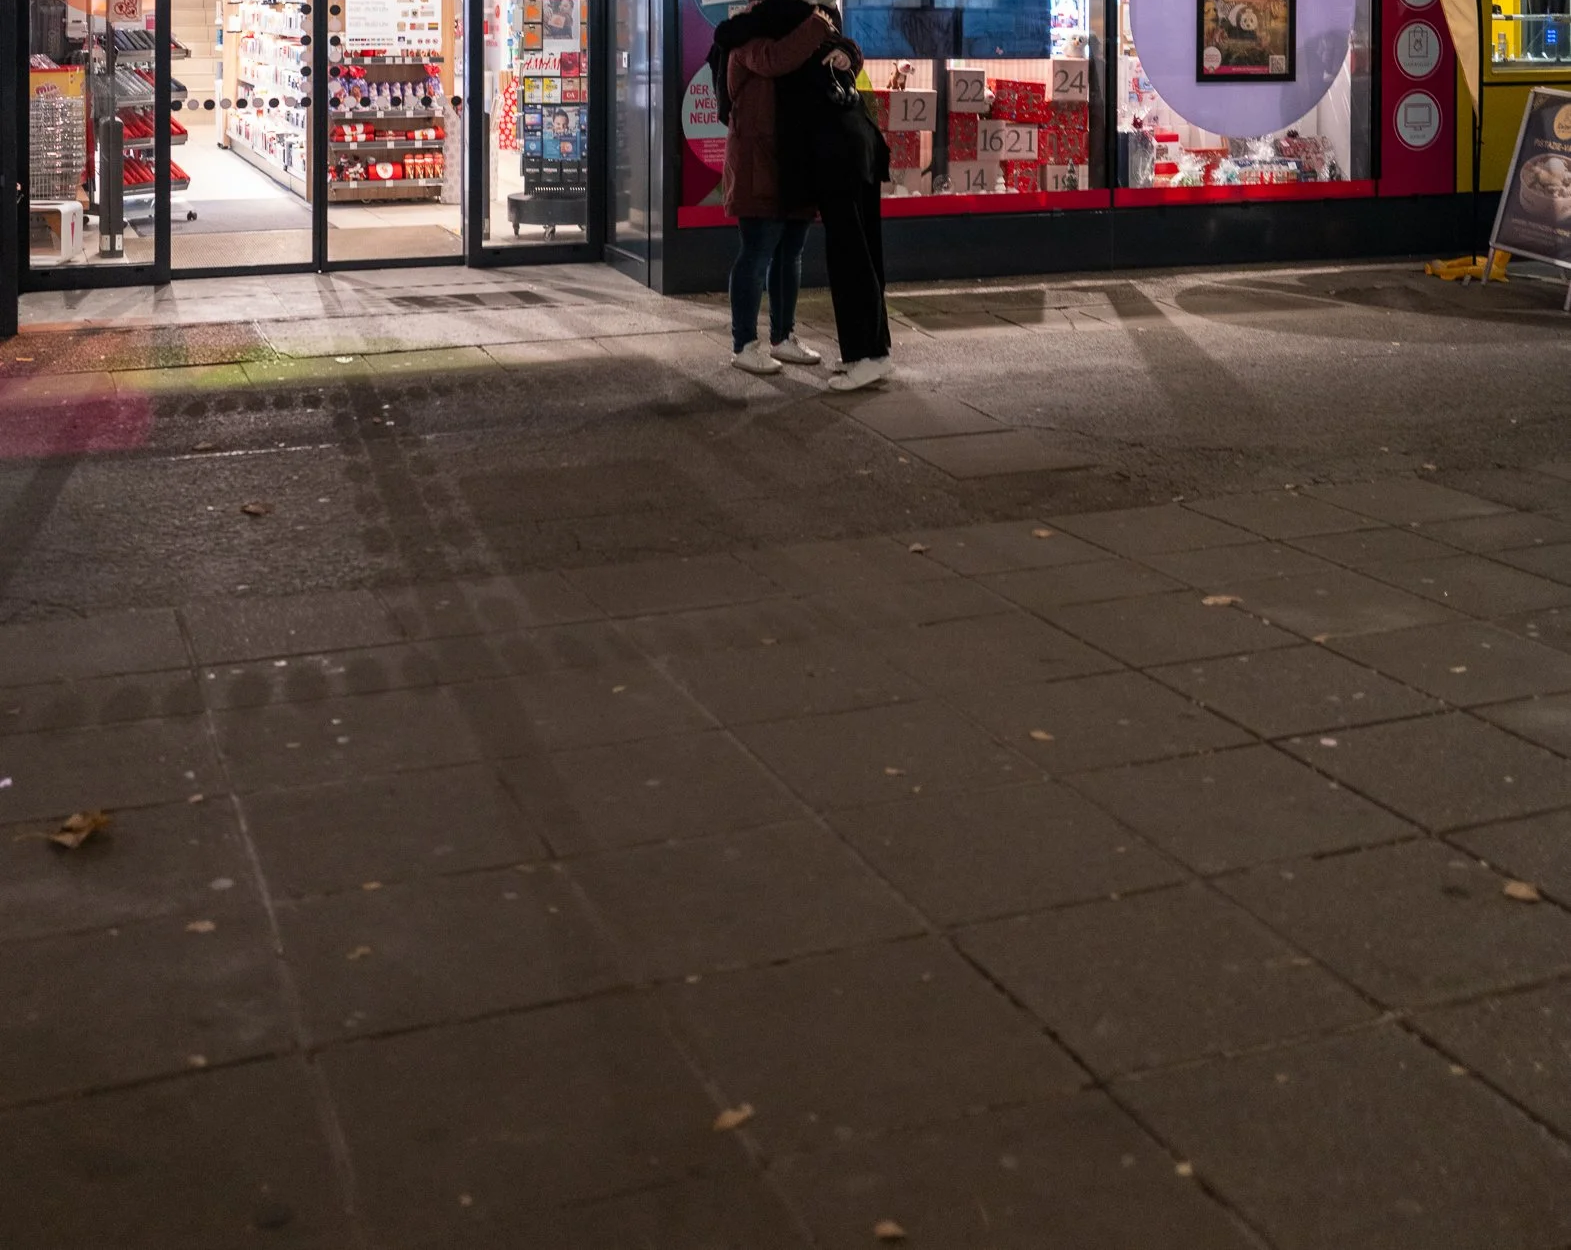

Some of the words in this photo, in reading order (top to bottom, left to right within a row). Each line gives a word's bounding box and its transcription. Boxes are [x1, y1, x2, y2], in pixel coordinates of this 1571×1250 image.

[690, 84, 709, 95] DER
[955, 78, 984, 103] 22
[1054, 69, 1086, 95] 24
[901, 97, 927, 122] 12
[980, 128, 1004, 152] 16
[1007, 129, 1035, 154] 21
[964, 169, 987, 191] 14
